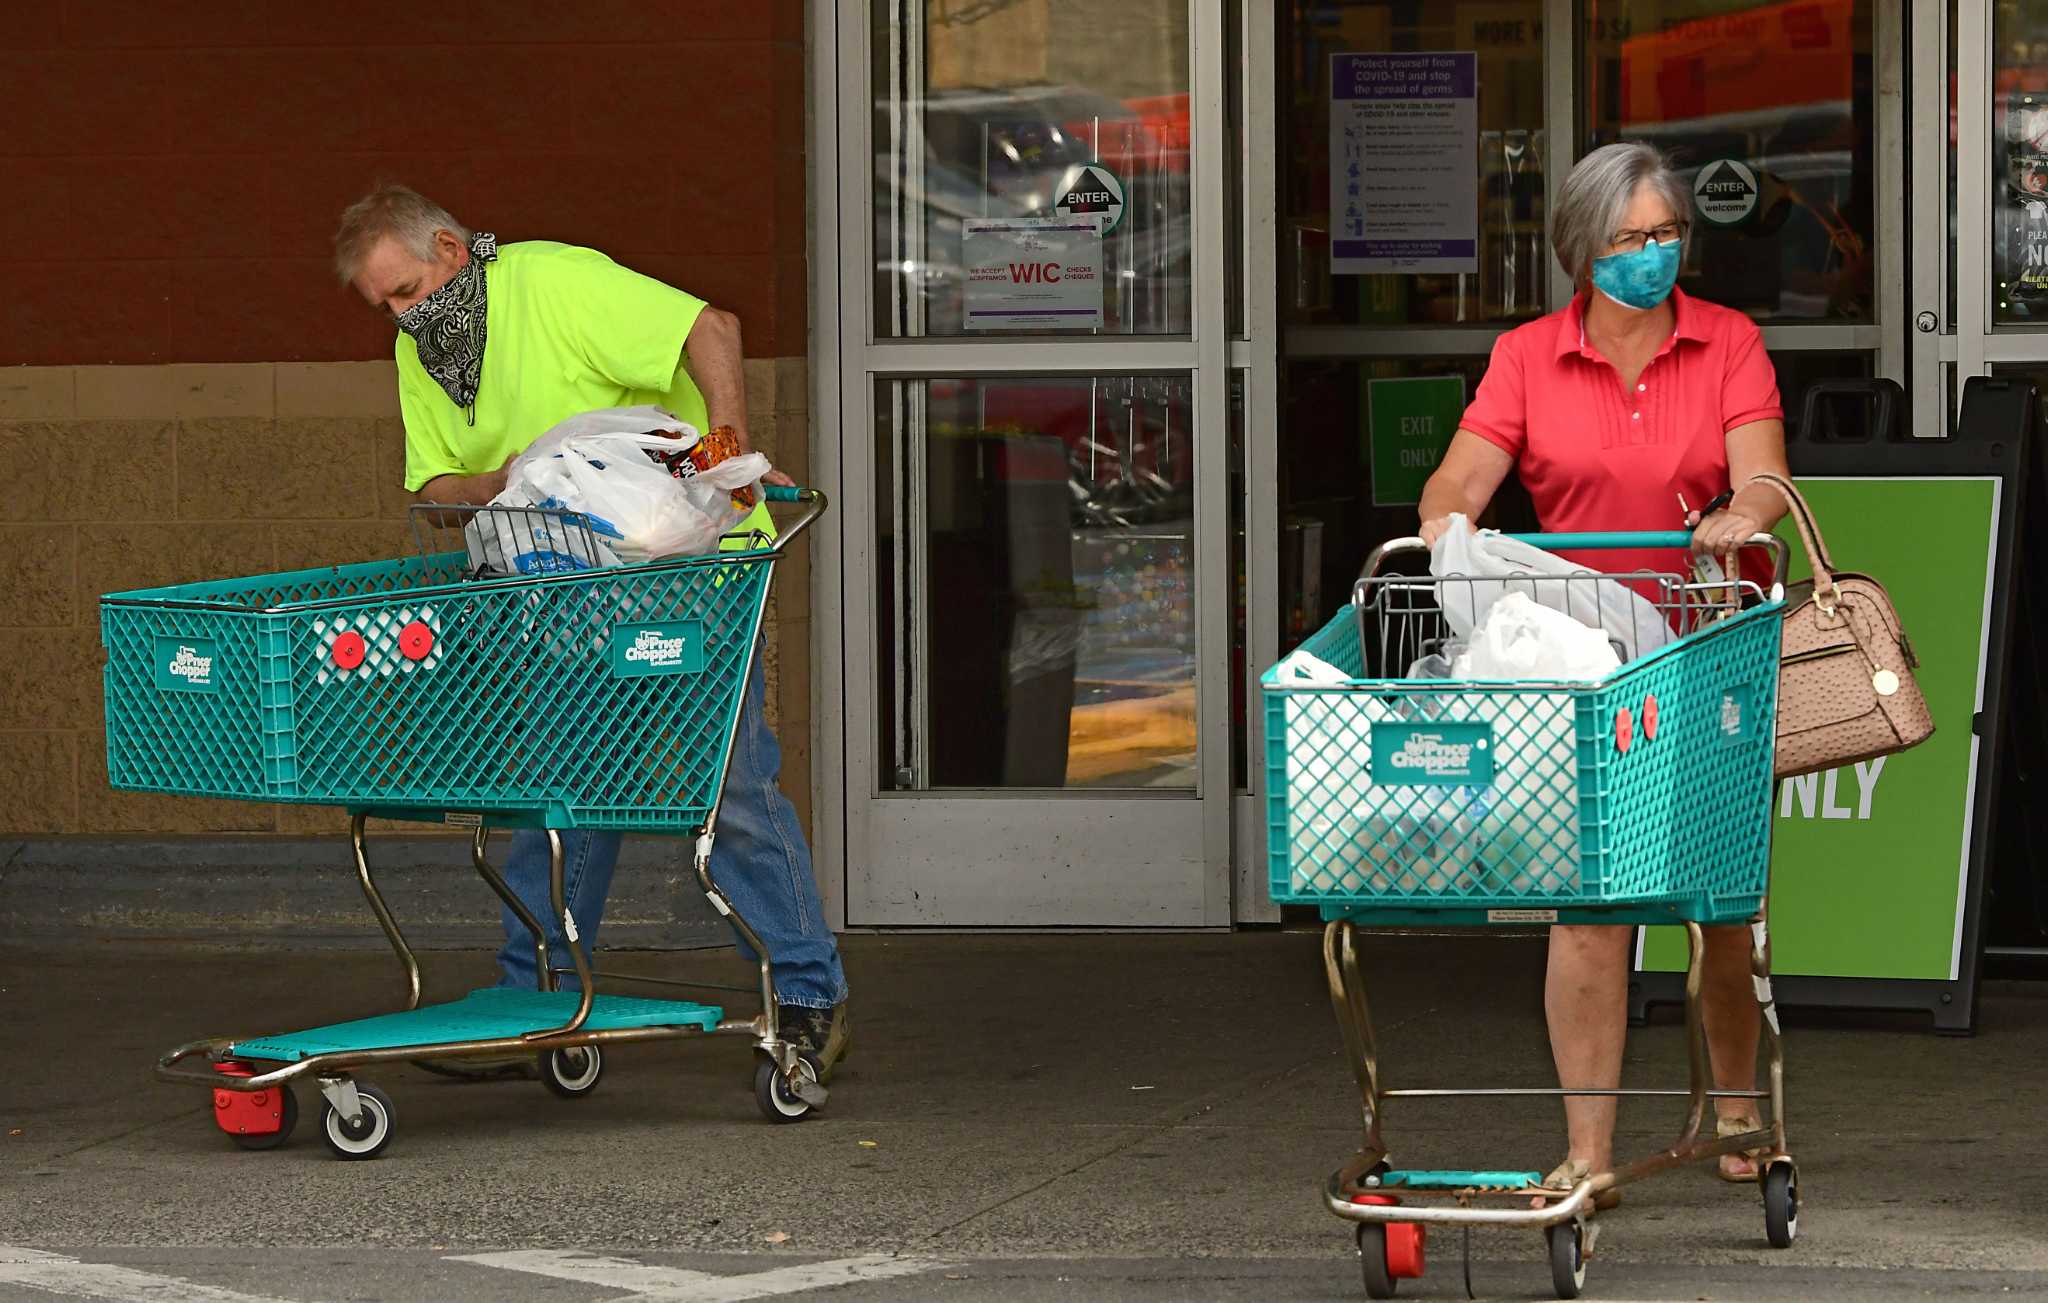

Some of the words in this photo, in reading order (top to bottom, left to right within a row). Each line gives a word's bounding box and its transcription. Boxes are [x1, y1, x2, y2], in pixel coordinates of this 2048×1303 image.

[1351, 58, 1387, 68] Protect
[1390, 58, 1429, 69] yourself
[1432, 57, 1456, 68] from
[1356, 71, 1405, 81] COVID-19
[1407, 71, 1427, 81] and
[1429, 71, 1451, 83] stop
[1354, 84, 1370, 95] the
[1374, 85, 1407, 96] spread
[1409, 84, 1420, 94] of
[1422, 86, 1453, 97] germs
[1705, 182, 1744, 193] ENTER
[1067, 191, 1109, 204] ENTER
[1705, 203, 1747, 212] welcome
[981, 267, 1006, 275] ACCEPT
[1009, 262, 1061, 284] WIC
[1400, 416, 1434, 436] EXIT
[1400, 448, 1438, 468] ONLY
[649, 636, 684, 651] Price
[625, 647, 683, 662] Chopper
[1424, 741, 1472, 756] Price
[1390, 751, 1470, 772] Chopper
[1780, 755, 1888, 820] NLY
